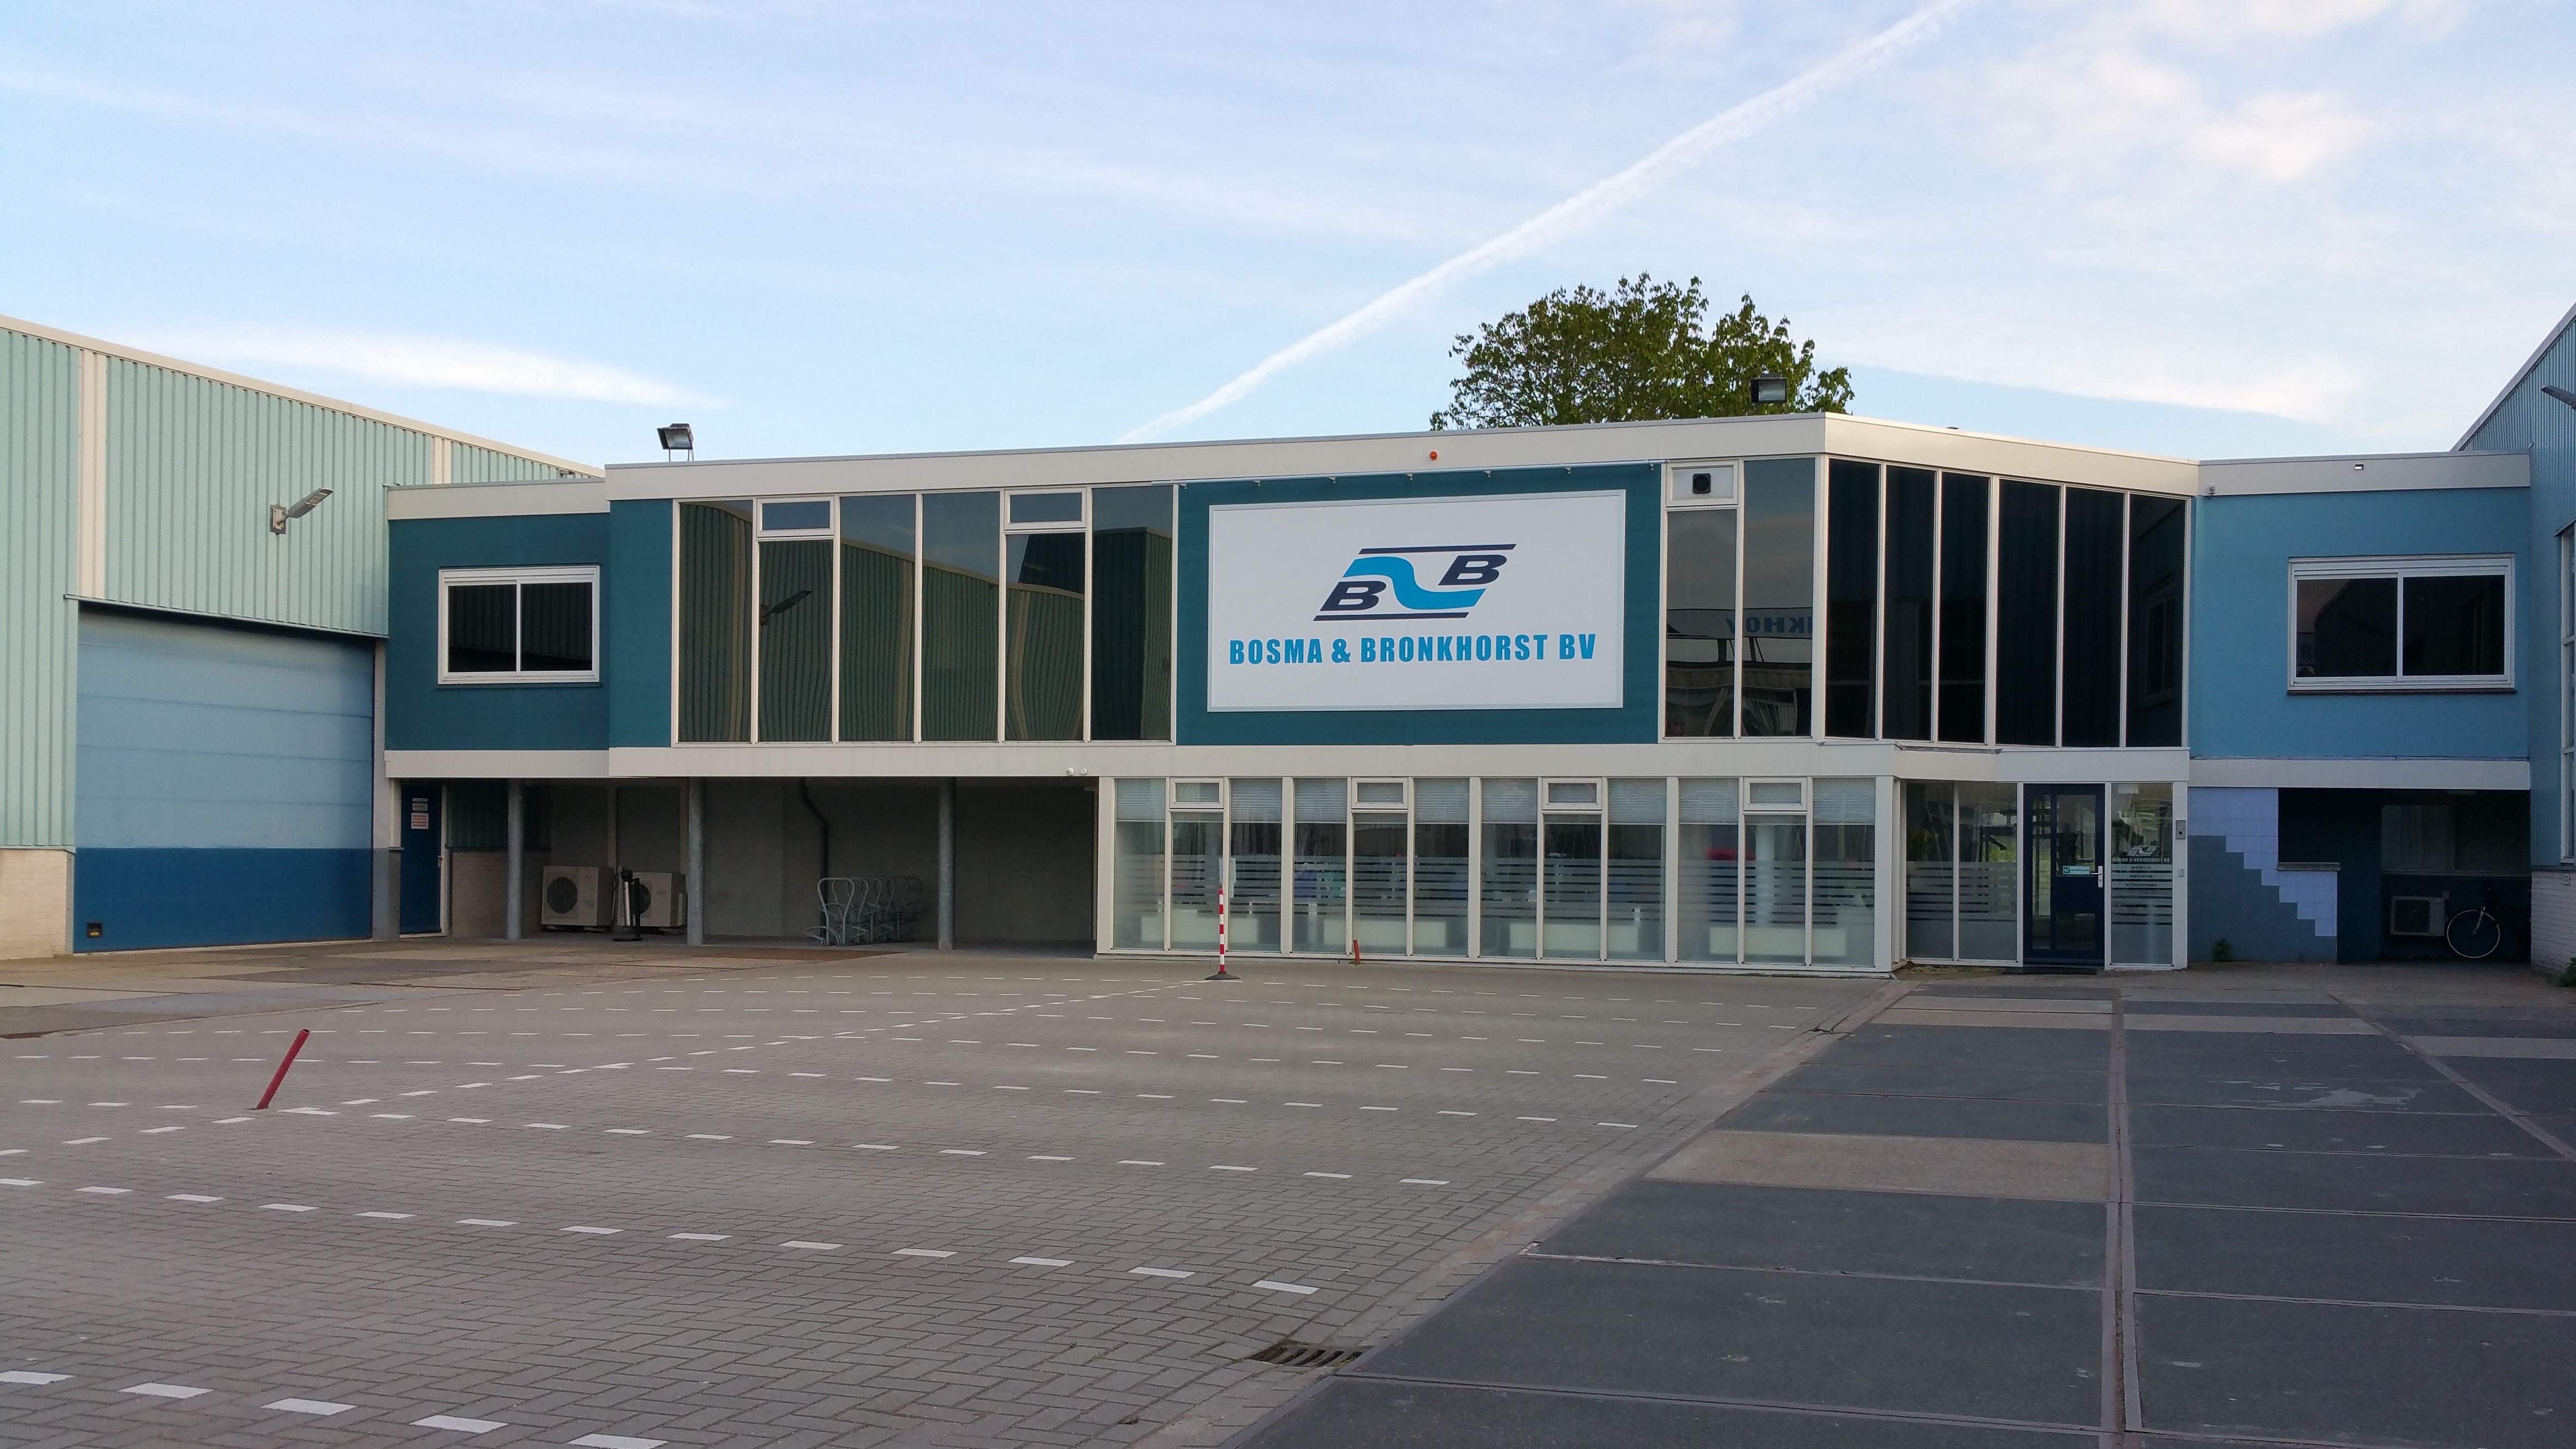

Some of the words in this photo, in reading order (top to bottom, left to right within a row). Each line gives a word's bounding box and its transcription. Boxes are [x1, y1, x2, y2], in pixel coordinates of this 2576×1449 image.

[1439, 554, 1507, 586] B
[1320, 580, 1387, 612] B
[1229, 638, 1323, 665] BOSMA
[1331, 638, 1350, 663] &
[1360, 634, 1548, 663] BRONKHORST
[1559, 634, 1596, 660] BV
